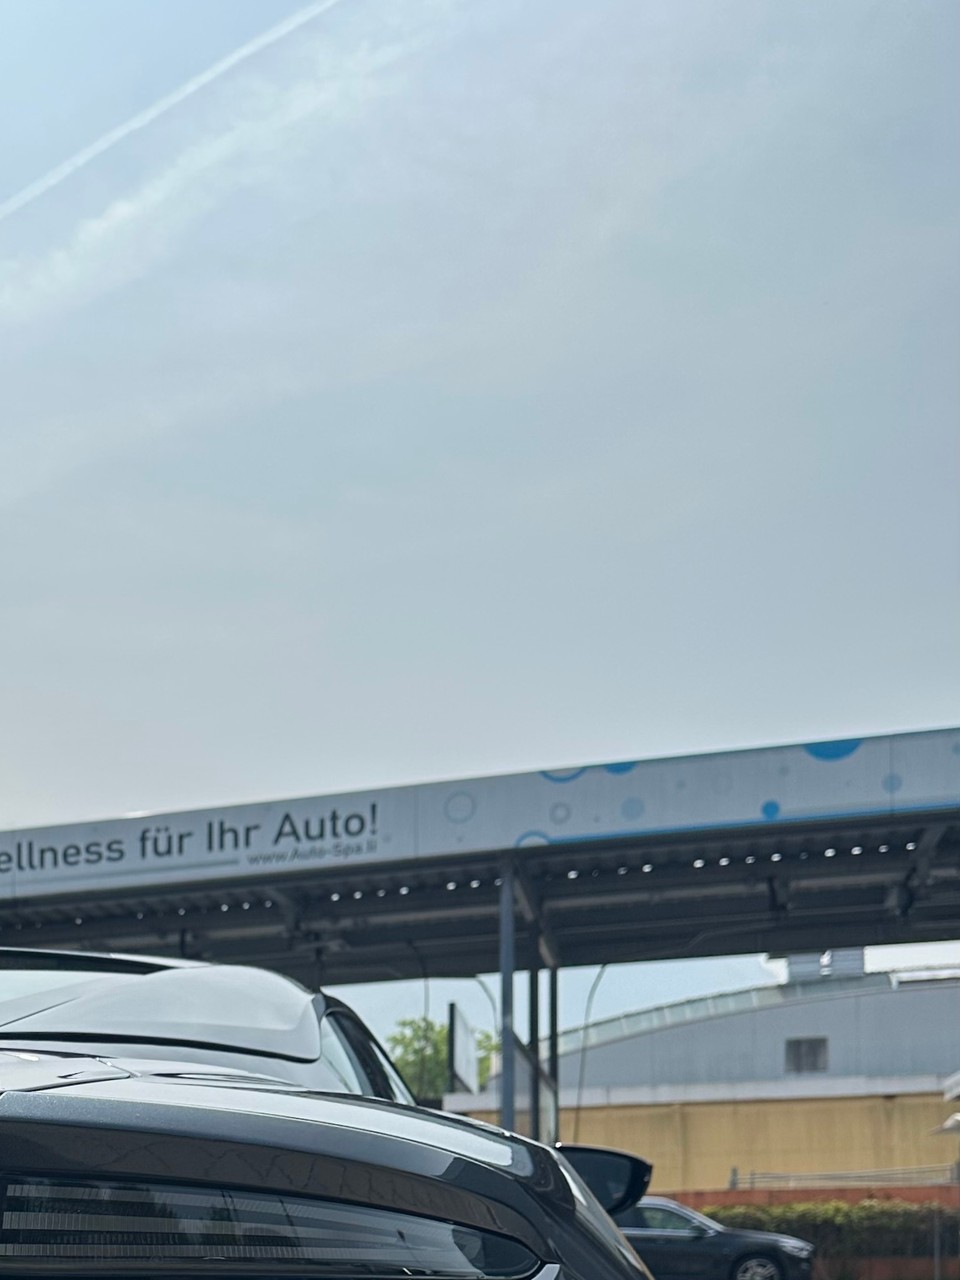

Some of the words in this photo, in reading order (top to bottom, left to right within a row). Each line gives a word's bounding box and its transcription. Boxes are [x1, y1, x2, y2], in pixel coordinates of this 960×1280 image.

[139, 827, 194, 859] für
[206, 821, 261, 852] Ihr
[273, 803, 379, 845] Auto!
